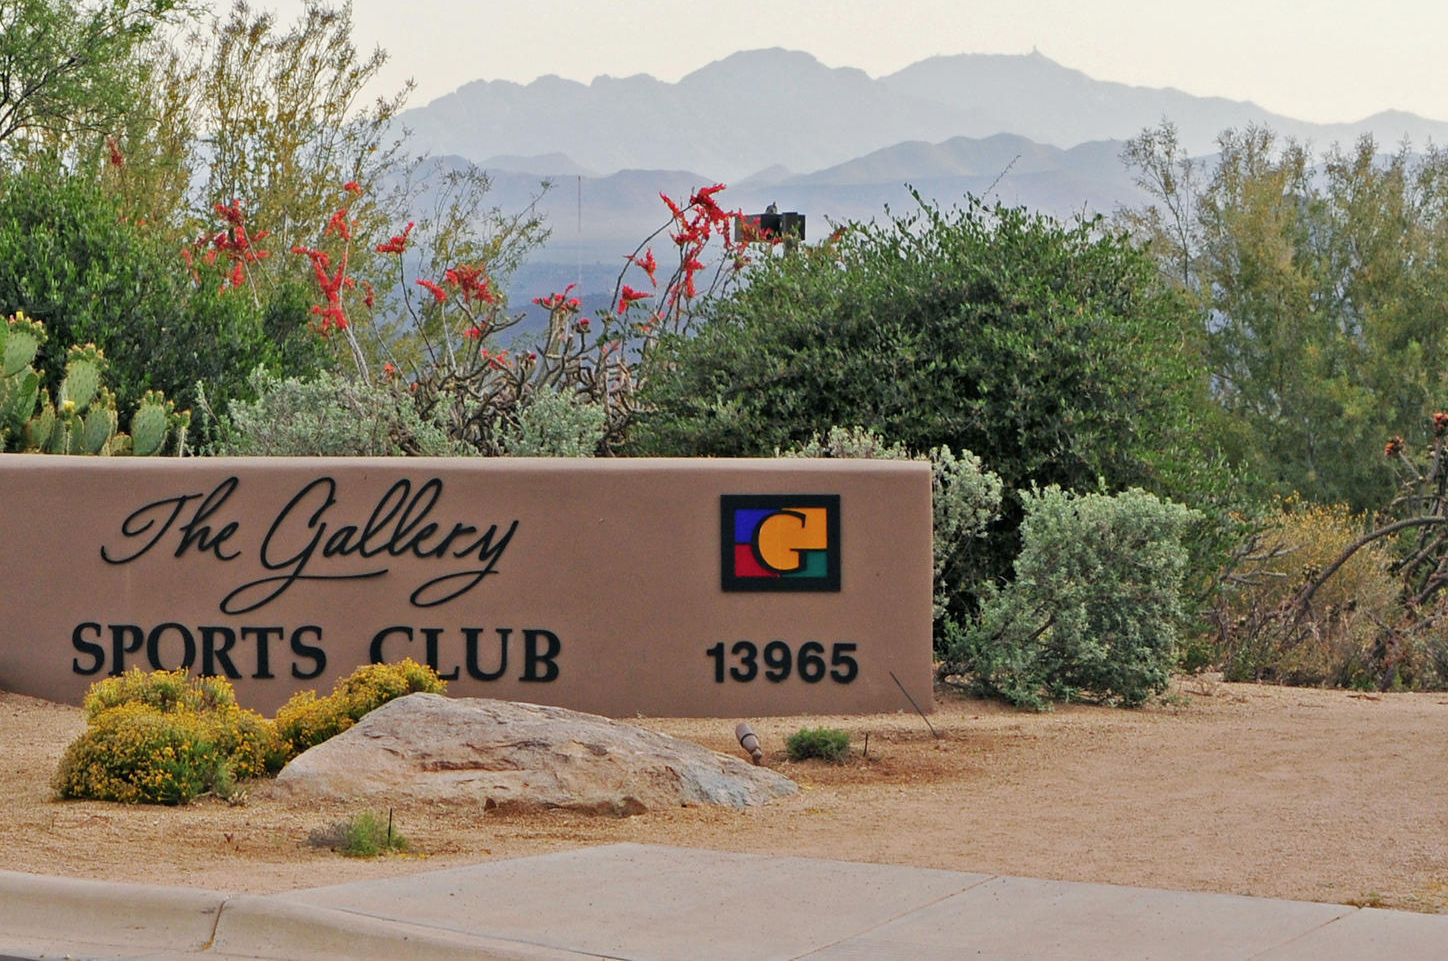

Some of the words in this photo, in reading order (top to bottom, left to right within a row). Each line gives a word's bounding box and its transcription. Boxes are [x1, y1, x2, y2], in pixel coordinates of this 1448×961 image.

[100, 476, 242, 565] The
[219, 476, 520, 616] Gallery
[71, 621, 328, 681] SPORTS
[368, 625, 563, 684] CLUB
[705, 640, 860, 685] 13965
